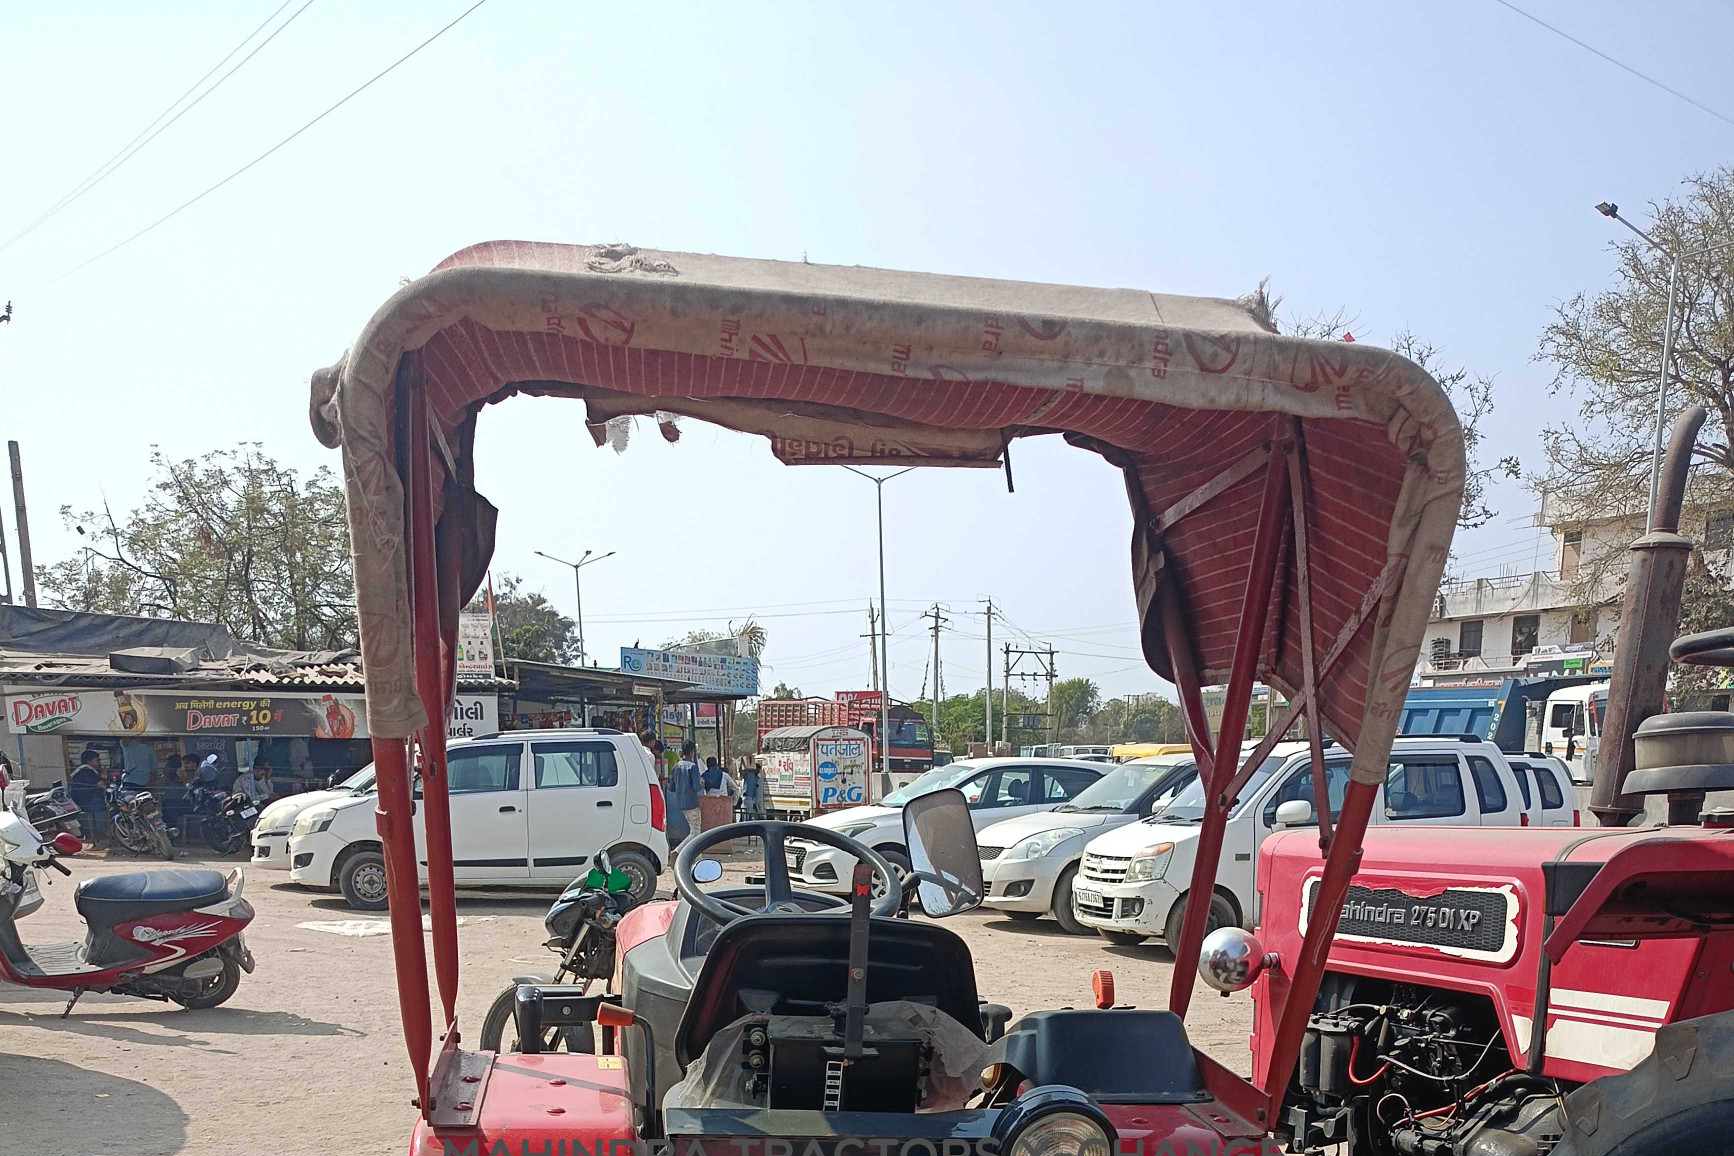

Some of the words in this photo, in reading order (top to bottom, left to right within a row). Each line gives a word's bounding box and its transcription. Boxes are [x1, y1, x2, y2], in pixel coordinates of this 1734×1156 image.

[13, 696, 79, 727] DAVAT
[216, 700, 257, 710] energy
[187, 709, 239, 731] DAVAT
[250, 709, 272, 724] 10
[821, 786, 863, 803] P&G
[1340, 900, 1406, 924] ahindra
[1411, 904, 1437, 928] 275
[1438, 906, 1455, 929] DI
[1457, 908, 1482, 932] XP
